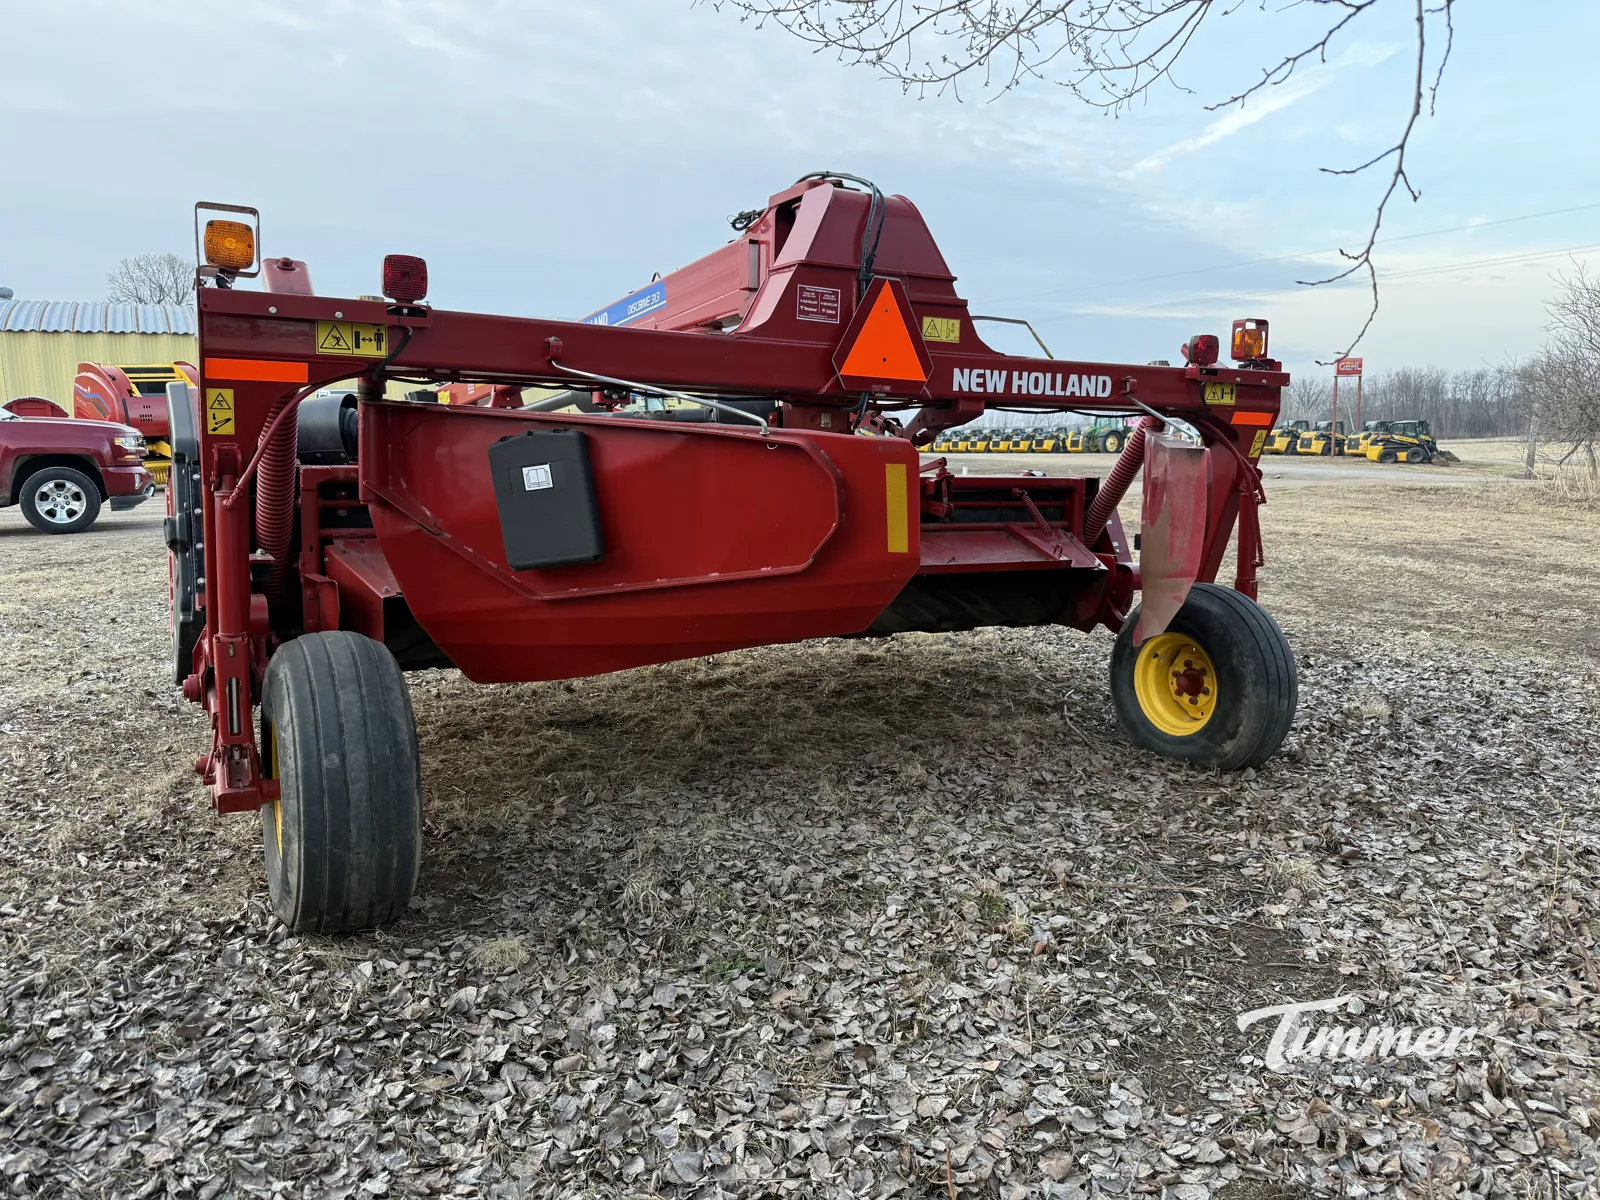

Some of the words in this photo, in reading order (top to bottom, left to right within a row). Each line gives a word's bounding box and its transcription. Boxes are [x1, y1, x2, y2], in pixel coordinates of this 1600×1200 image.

[628, 296, 650, 315] DISCBINE
[650, 292, 660, 305] 313
[1339, 362, 1362, 371] GEHL
[952, 367, 1007, 394] NEW
[1011, 371, 1112, 398] HOLLAND
